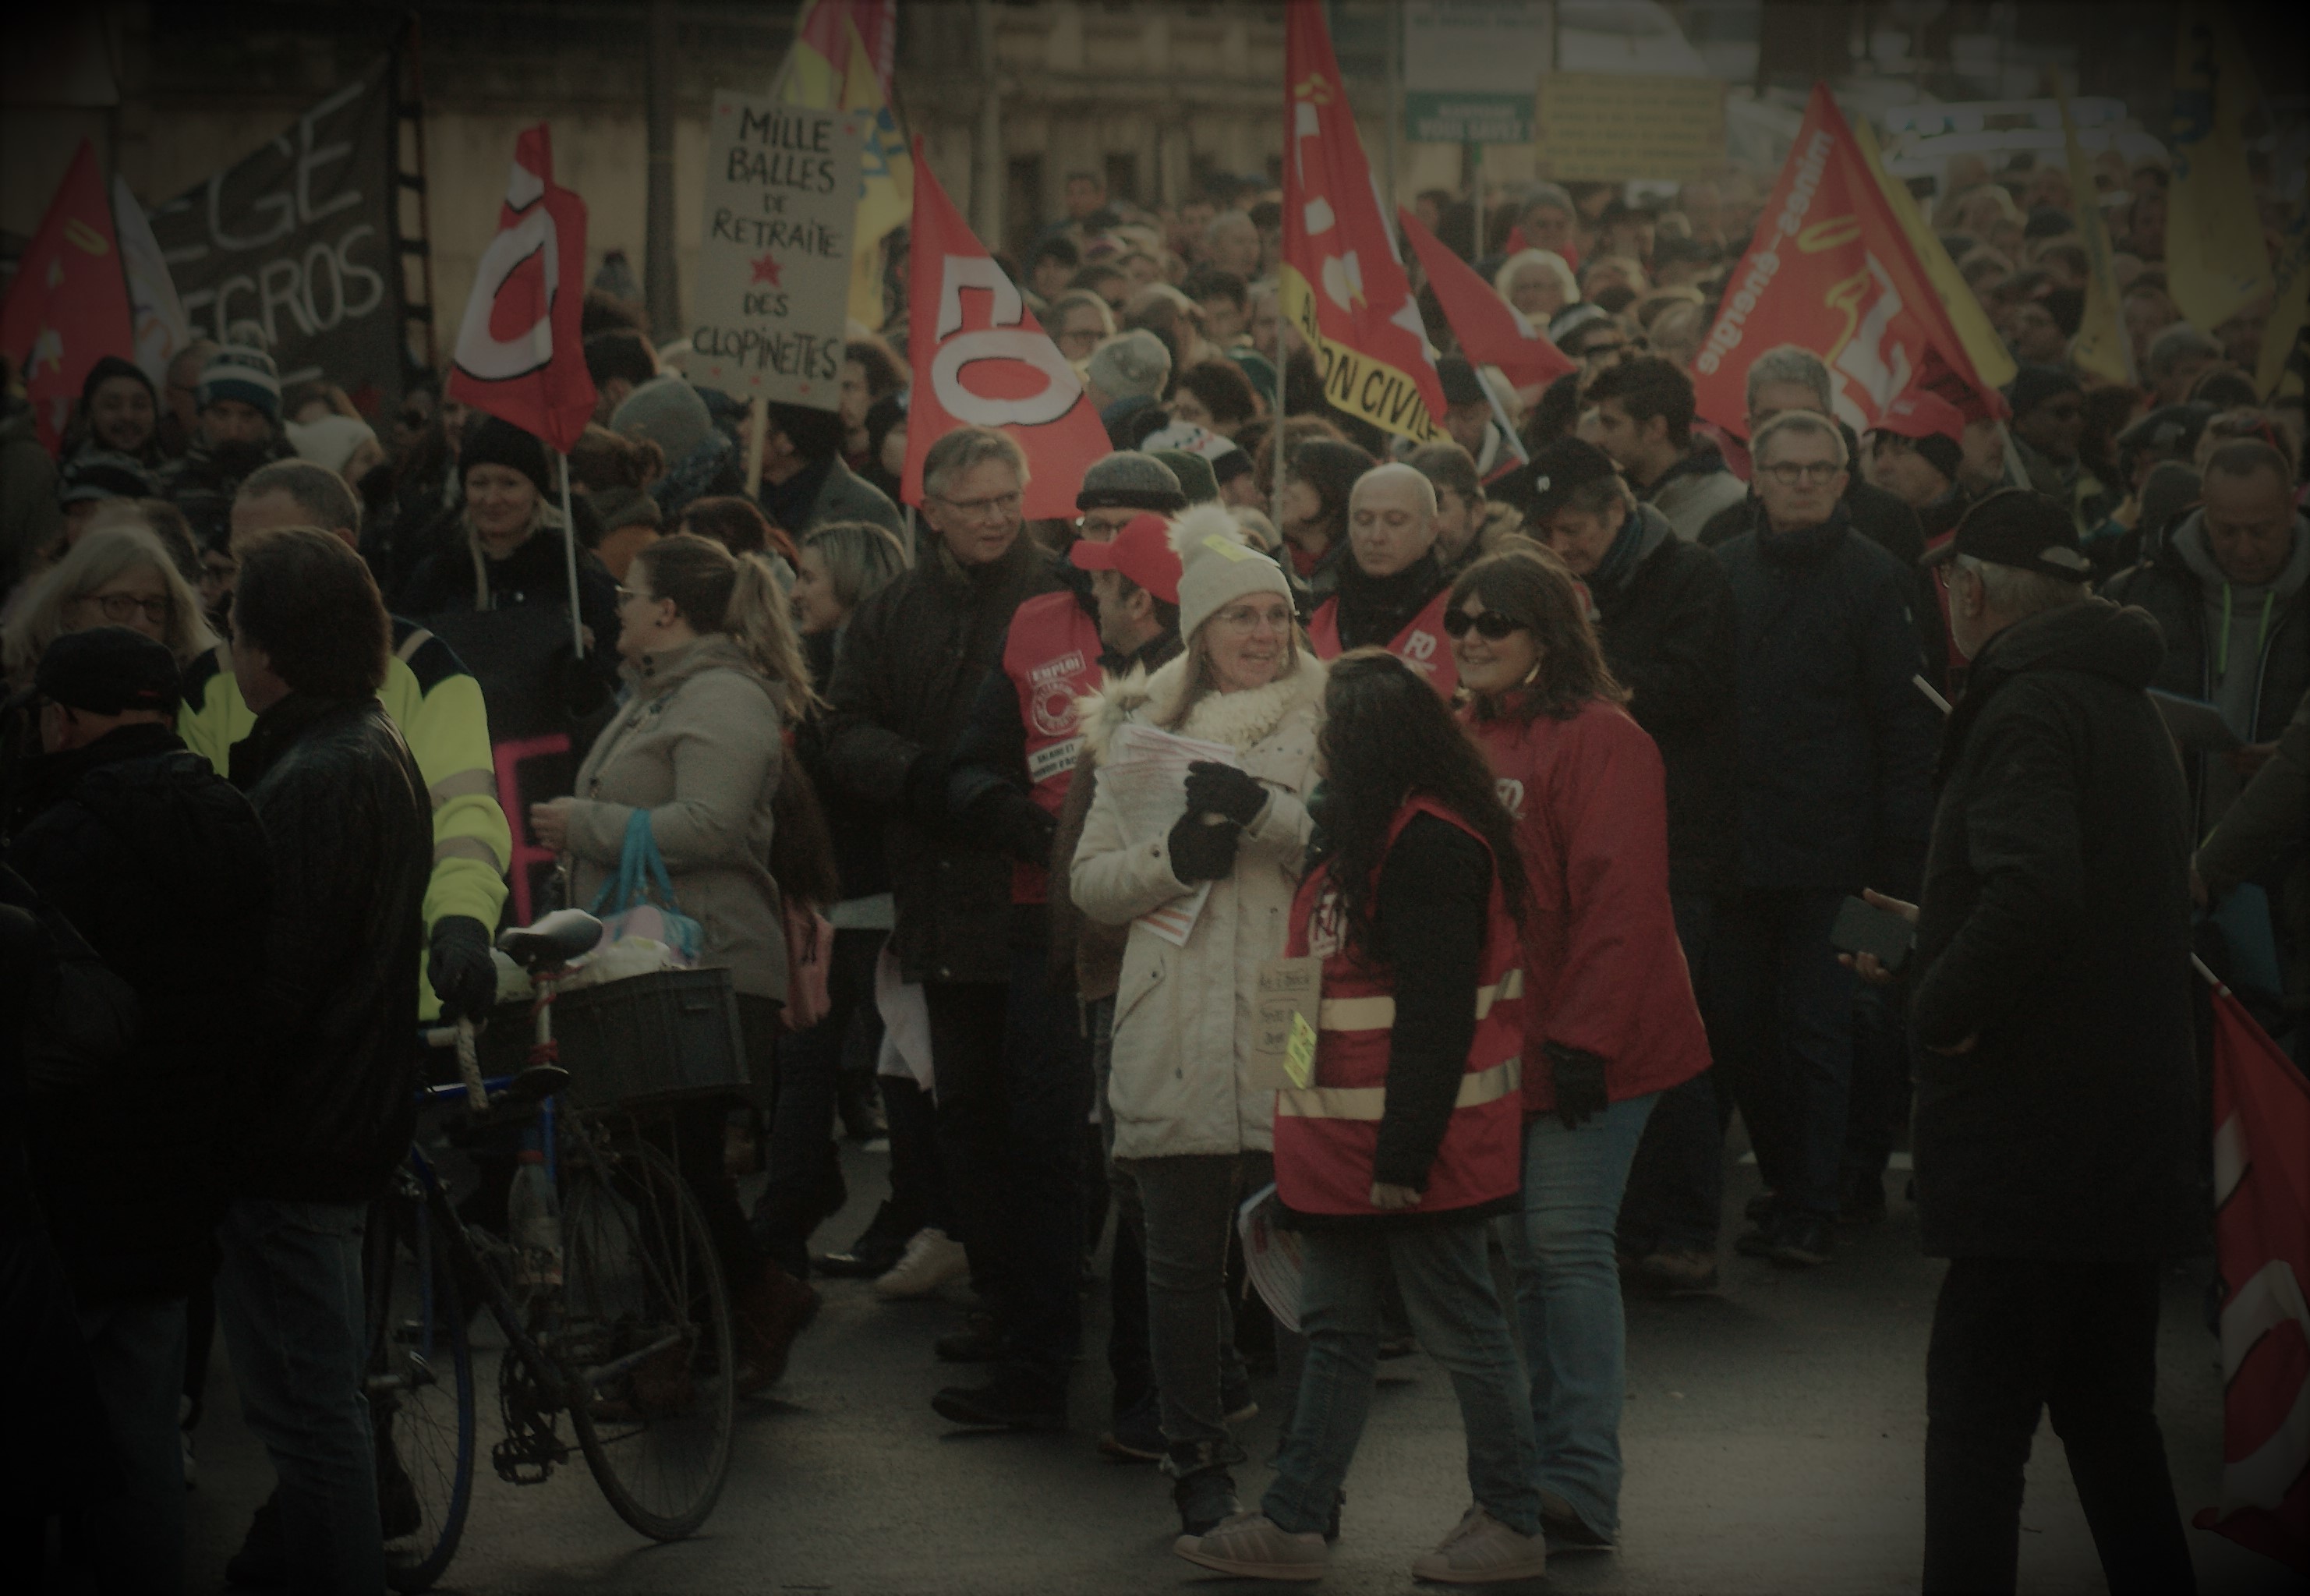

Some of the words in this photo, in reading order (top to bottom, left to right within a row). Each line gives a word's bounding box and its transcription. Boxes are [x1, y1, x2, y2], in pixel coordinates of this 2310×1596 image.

[727, 146, 836, 194] BALLES
[762, 192, 787, 214] DE
[743, 291, 789, 318] DES
